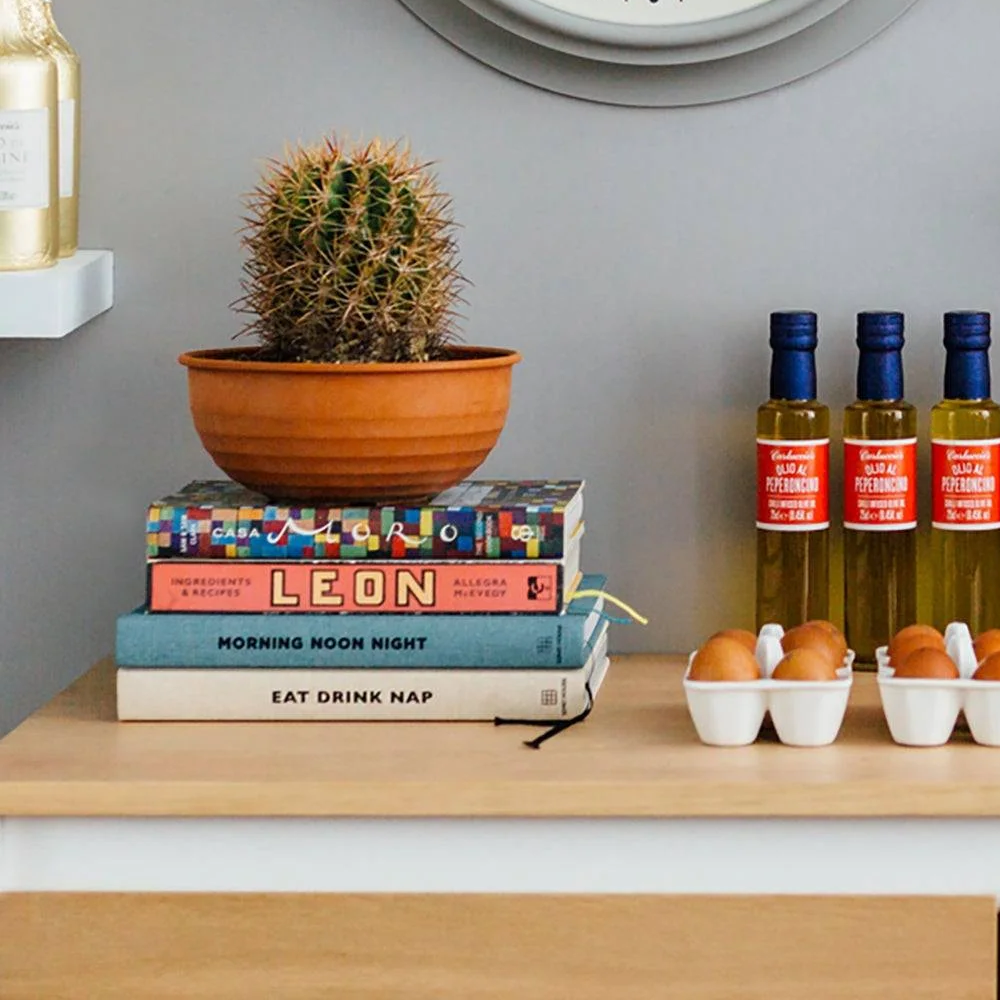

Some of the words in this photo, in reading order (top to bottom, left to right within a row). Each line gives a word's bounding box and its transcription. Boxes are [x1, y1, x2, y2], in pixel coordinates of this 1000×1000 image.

[775, 463, 797, 476] OLIO
[796, 464, 808, 476] AL
[864, 463, 886, 475] OLIO
[887, 464, 898, 475] AL
[951, 463, 973, 475] OLIO
[973, 464, 985, 475] AL
[212, 528, 261, 538] CASA
[266, 516, 458, 544] MORO
[170, 577, 252, 586] INGREDIENTS
[453, 578, 508, 587] ALLEGRA
[182, 589, 189, 597] &
[192, 589, 241, 597] RECIPES
[271, 569, 436, 607] LEON
[218, 636, 303, 650] MORNING
[311, 637, 364, 650] NOON
[372, 637, 427, 650] NIGHT
[271, 691, 309, 704] EAT
[317, 691, 382, 704] DRINK
[390, 691, 433, 704] NAP
